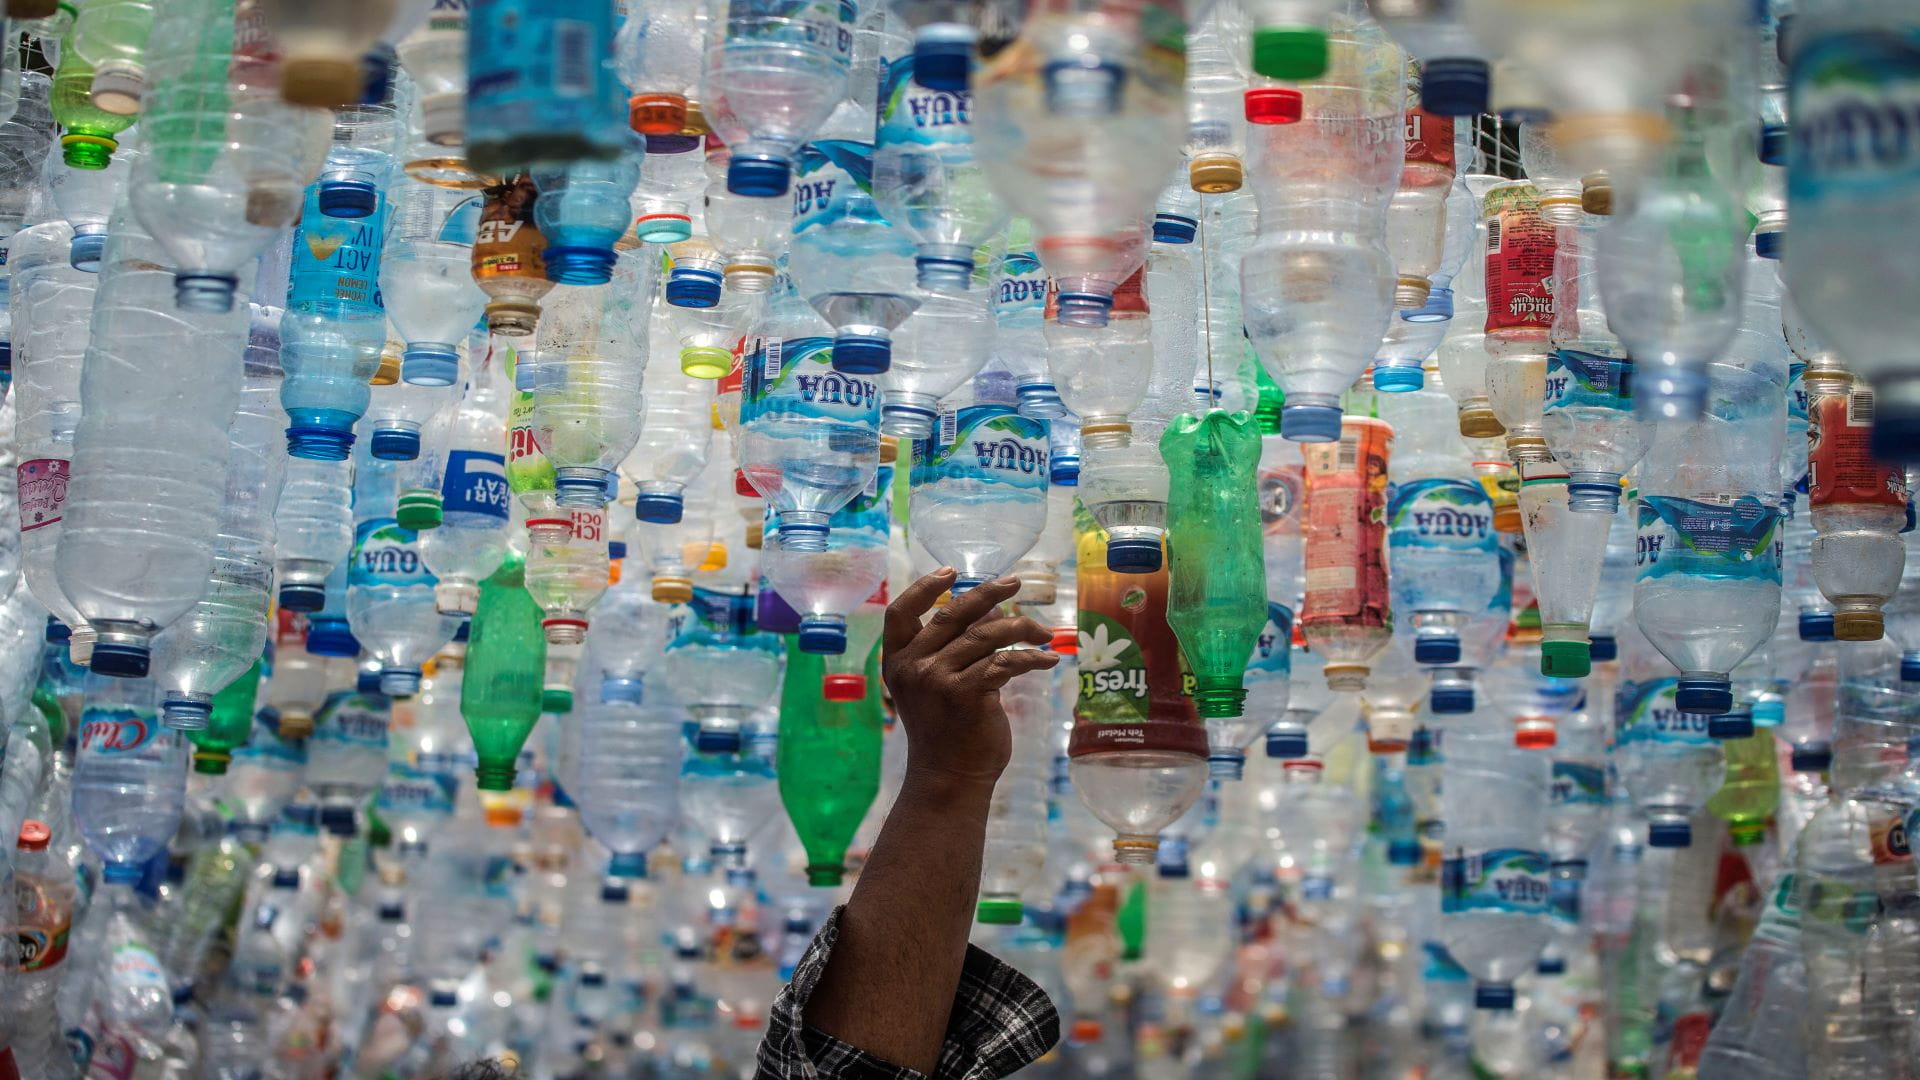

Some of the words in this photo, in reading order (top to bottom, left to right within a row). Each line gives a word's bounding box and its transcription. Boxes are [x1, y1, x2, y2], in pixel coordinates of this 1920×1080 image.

[909, 91, 971, 128] QUA
[793, 180, 837, 217] AQ
[333, 247, 372, 272] ACT
[335, 288, 367, 303] LYCHEE
[337, 276, 369, 291] LEMON
[797, 371, 877, 411] AQUA
[973, 437, 1049, 478] AQUA
[1414, 507, 1490, 539] AQUA
[81, 719, 147, 751] Club
[1096, 728, 1127, 739] Melati
[1127, 728, 1144, 737] Teh
[1651, 709, 1708, 733] QUA
